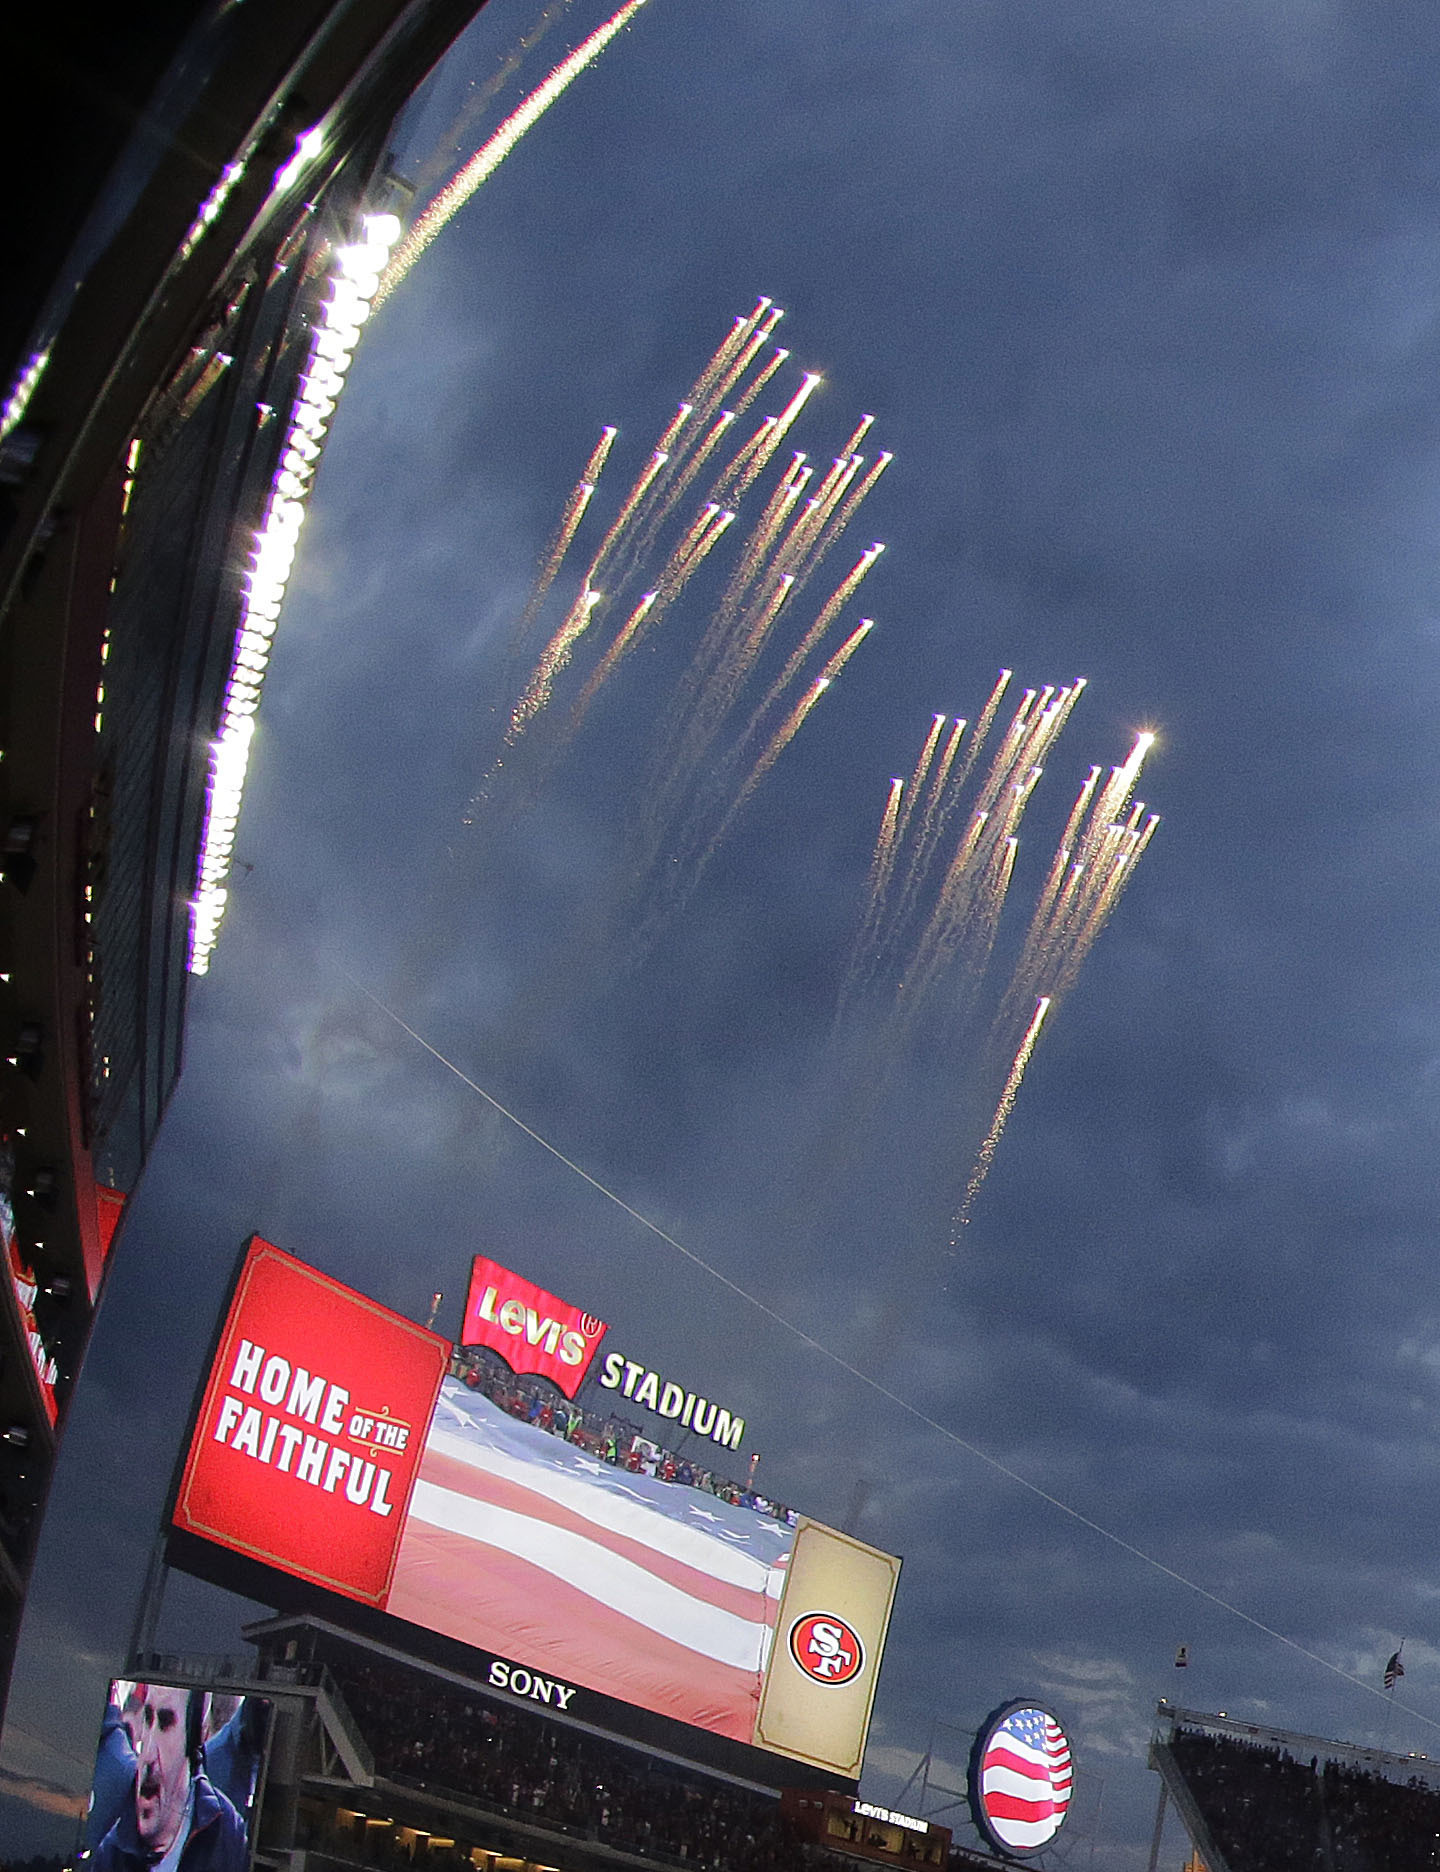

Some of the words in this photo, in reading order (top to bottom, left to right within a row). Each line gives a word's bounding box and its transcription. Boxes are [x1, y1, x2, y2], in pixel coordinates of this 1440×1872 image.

[229, 1339, 350, 1437] HOME
[348, 1413, 374, 1440] OF
[374, 1419, 410, 1451] THE
[600, 1351, 747, 1451] STADIUM
[215, 1394, 395, 1518] FAITHFUL
[488, 1661, 578, 1711] SONY
